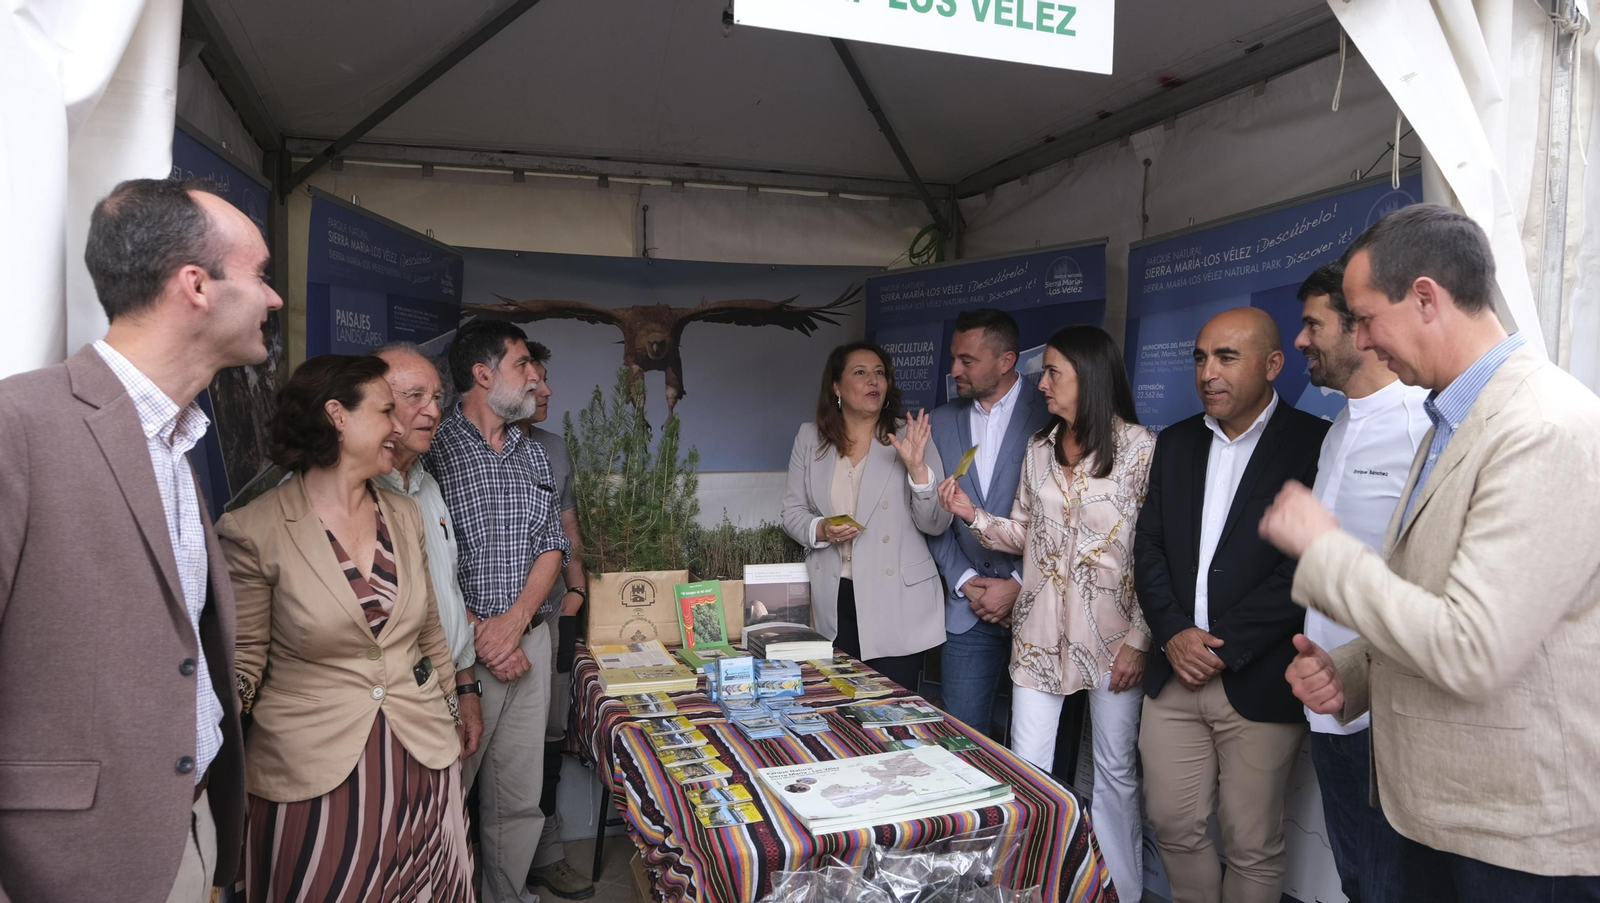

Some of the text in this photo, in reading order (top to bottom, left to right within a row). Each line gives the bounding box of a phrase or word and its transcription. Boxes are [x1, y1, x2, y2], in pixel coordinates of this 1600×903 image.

[328, 217, 370, 241] PARQUE NATURAL
[1256, 202, 1338, 254] ¡Descúbrelo!
[328, 230, 350, 248] SIERRA
[383, 248, 398, 264] VÉLEZ
[328, 249, 345, 262] SIERRA
[1146, 245, 1202, 266] PARQUE NATURAL
[1285, 226, 1353, 269] Discover it!
[1144, 246, 1252, 280] SIERRA MARÍA-LOS VÉLEZ
[968, 261, 1029, 293] ¡Descúbrelo!
[1044, 281, 1061, 289] Sierra
[1142, 282, 1165, 294] SIERRA
[1203, 269, 1223, 282] VÉLEZ
[1224, 263, 1260, 278] NATURAL
[1262, 258, 1282, 272] PARK
[880, 281, 926, 293] PARQUE NATURAL
[880, 292, 901, 303] SIERRA
[942, 283, 963, 295] VÉLEZ
[987, 277, 1037, 303] Discover it!
[1048, 286, 1083, 297] Los Vélez
[942, 296, 969, 307] NATURAL
[969, 295, 986, 304] PARK
[335, 309, 371, 331] PAISAJES
[335, 326, 383, 347] LANDSCAPES
[1142, 342, 1170, 351] MUNICIPIOS
[1178, 340, 1196, 348] PARQUE
[892, 353, 934, 367] ANADERÍA
[1137, 391, 1155, 399] 22.562
[1138, 382, 1165, 392] EXTENSIÓN:
